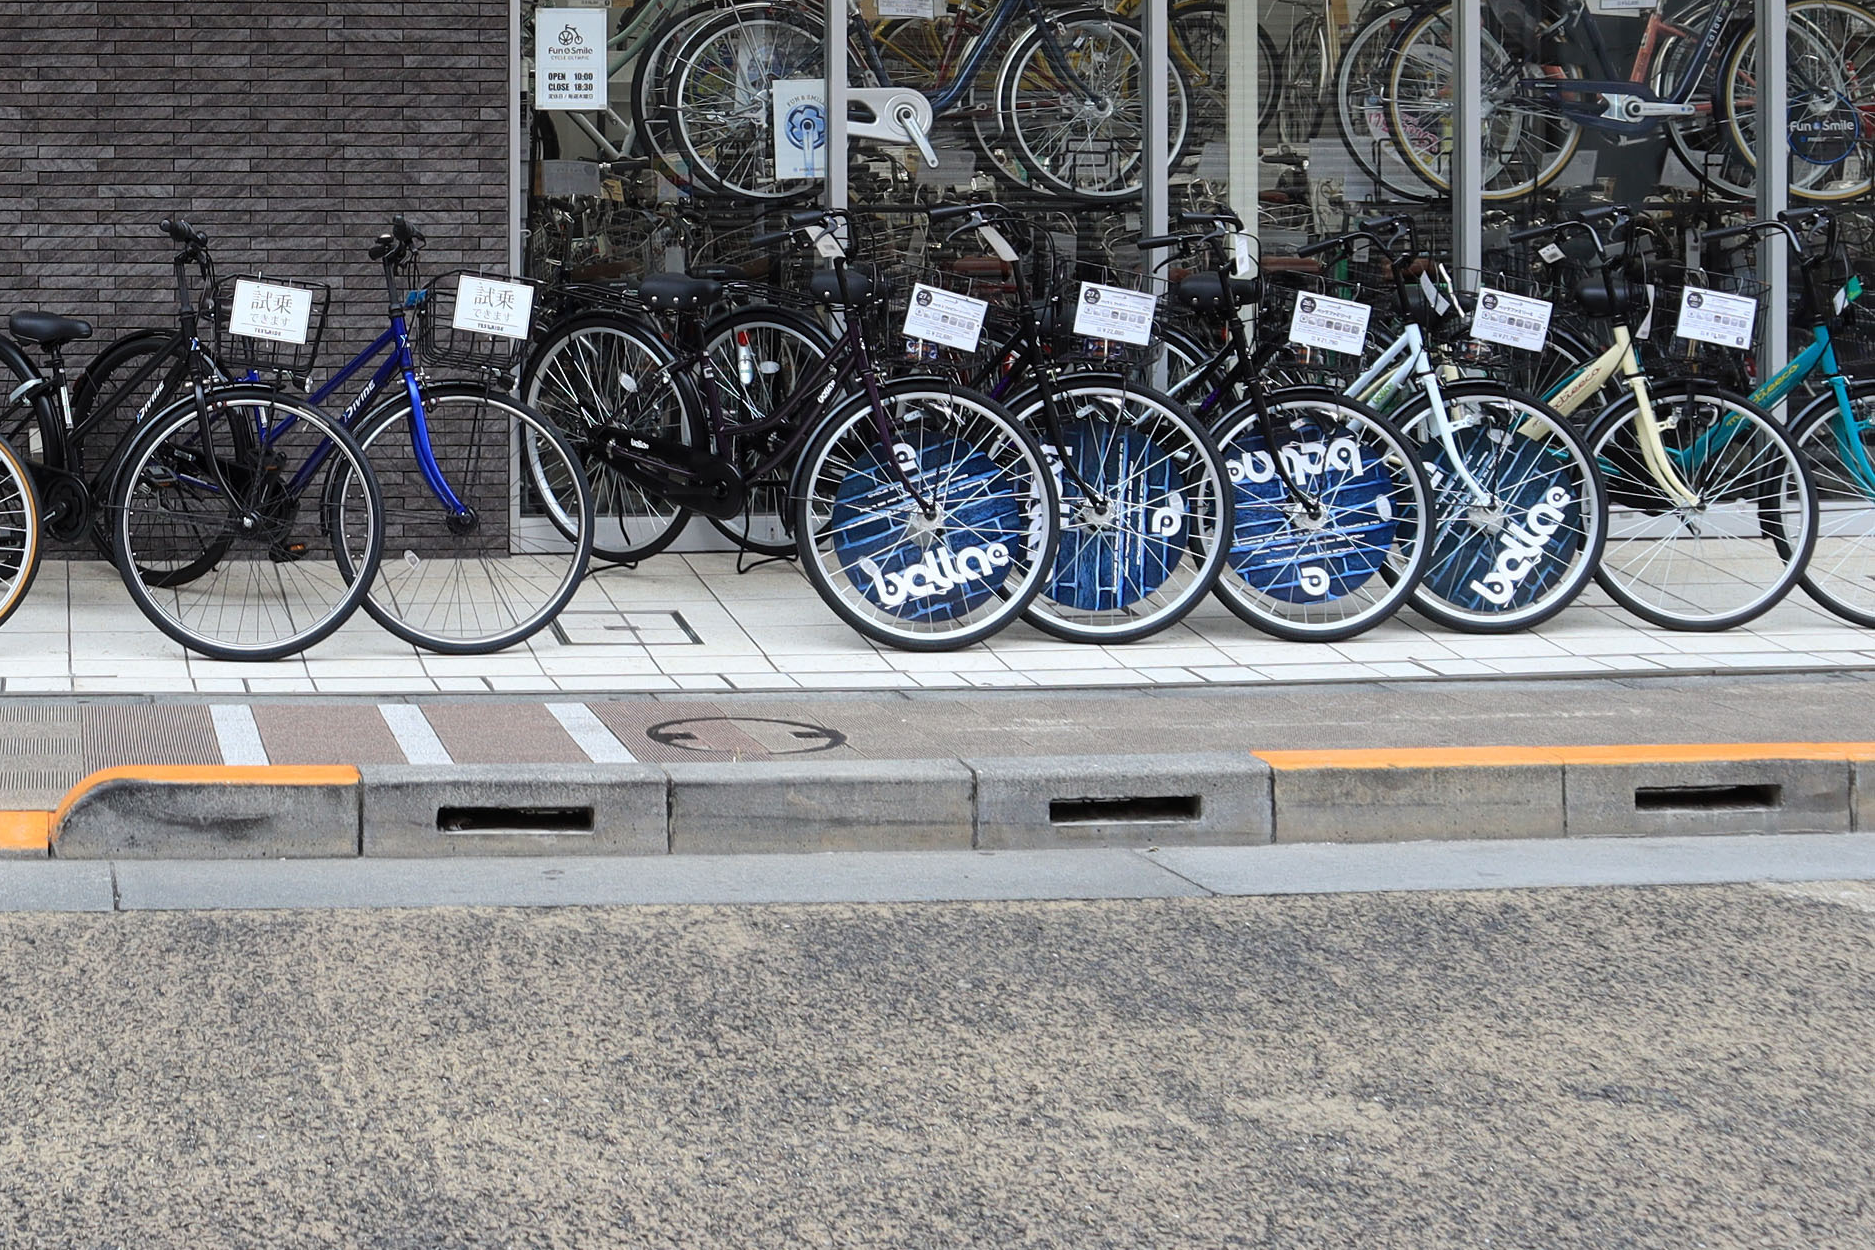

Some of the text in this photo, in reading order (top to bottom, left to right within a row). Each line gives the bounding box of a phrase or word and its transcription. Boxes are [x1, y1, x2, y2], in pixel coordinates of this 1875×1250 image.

[548, 47, 593, 55] Fun Smile
[548, 72, 593, 81] OPEN 10:00
[548, 83, 593, 91] CLOSE 18:30
[1789, 121, 1812, 131] Fun
[1822, 120, 1854, 130] Smile
[251, 290, 293, 315] 試乗
[474, 286, 515, 310] 試乗
[250, 313, 291, 327] できます
[472, 308, 513, 321] できます
